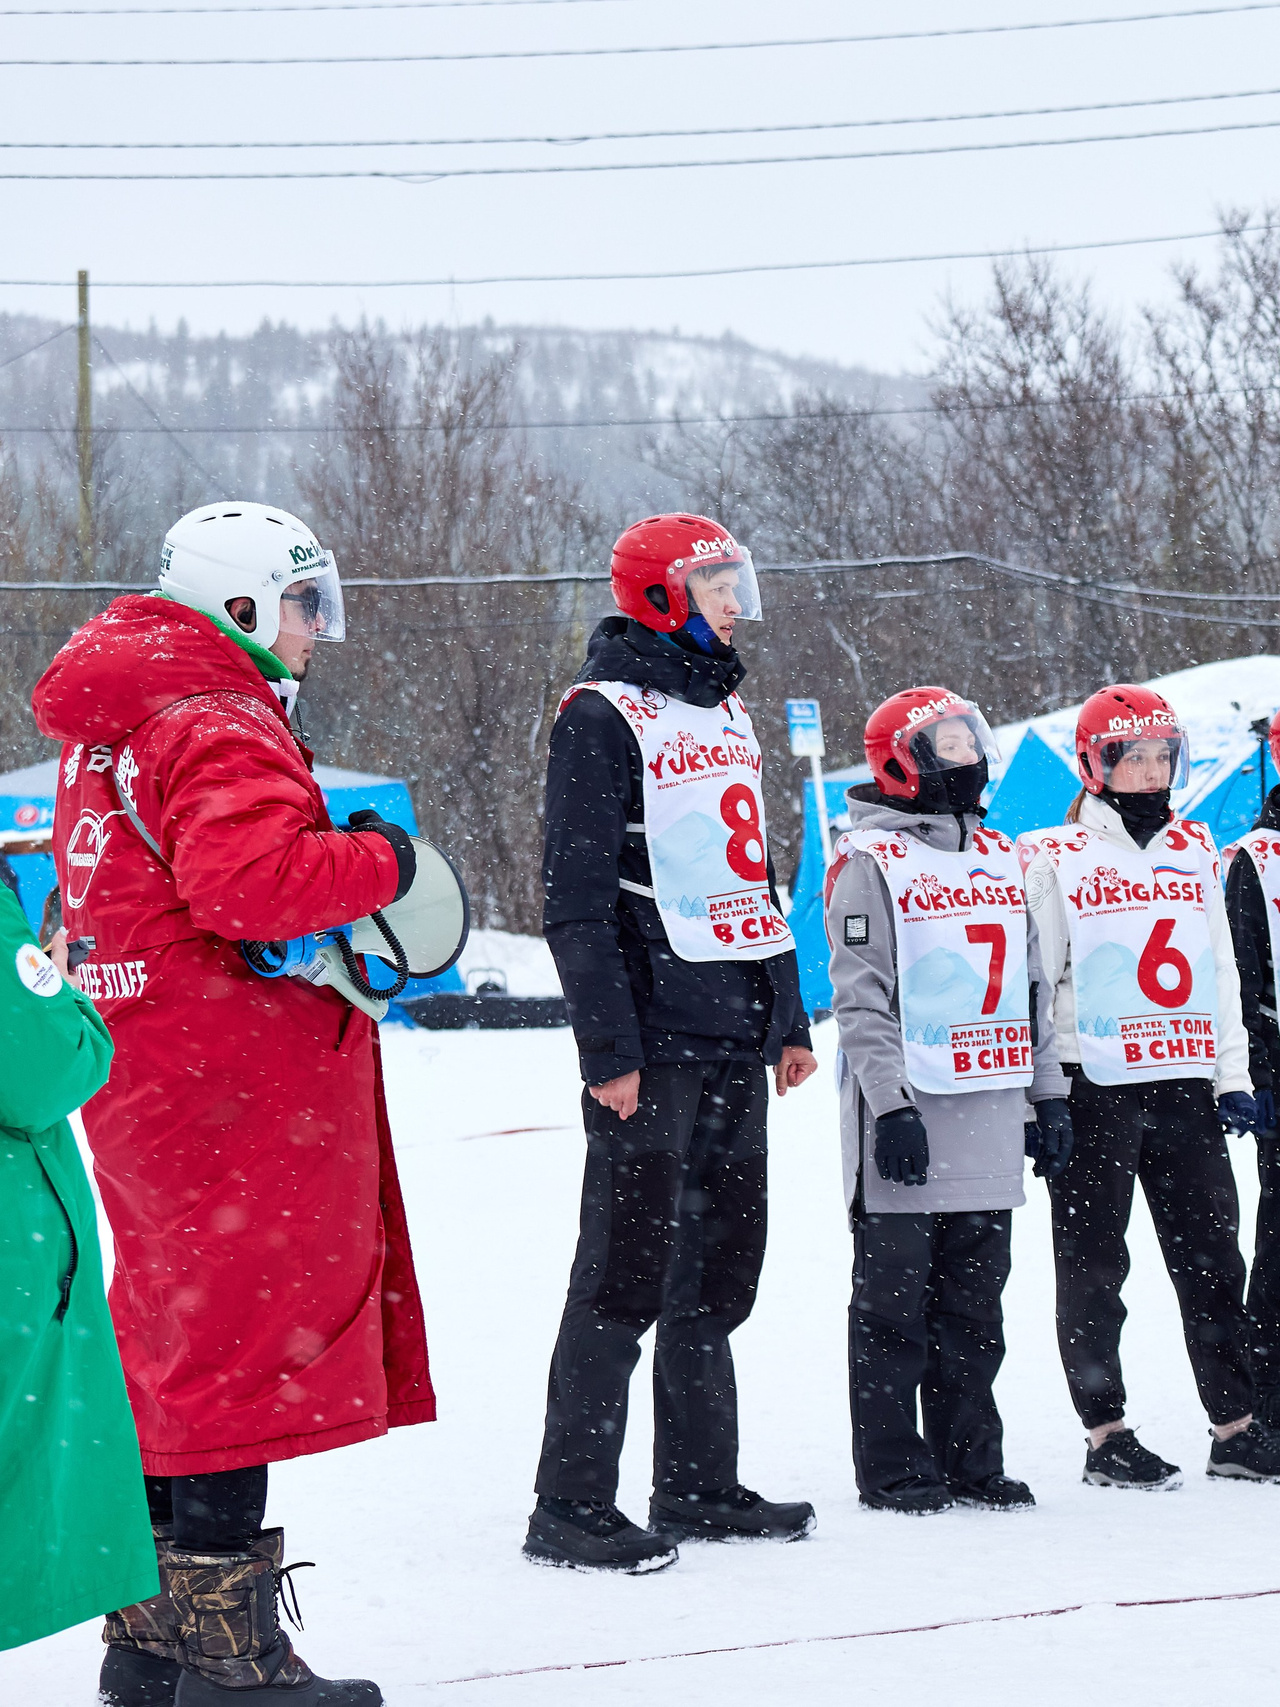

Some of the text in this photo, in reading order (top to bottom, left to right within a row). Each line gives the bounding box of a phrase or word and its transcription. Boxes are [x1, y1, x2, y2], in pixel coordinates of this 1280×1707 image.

[291, 557, 323, 574] МУРМАНС
[720, 783, 769, 882] 8
[709, 900, 733, 913] ДЛЯ
[710, 906, 759, 921] КТО ЗНАЕТ
[713, 923, 735, 945] В
[964, 923, 1007, 1016] 7
[1137, 918, 1193, 1009] 6
[100, 960, 148, 999] STAFF
[951, 1030, 973, 1041] ДЛЯ
[994, 1026, 1031, 1043] ТОЛ
[1120, 1022, 1143, 1033] ДЛЯ
[1169, 1018, 1214, 1036] ТОЛК
[1122, 1030, 1167, 1040] КТО ЗНАЕТ
[952, 1041, 969, 1049] КТО
[1124, 1039, 1216, 1063] В СНЕГЕ
[953, 1052, 972, 1073] В
